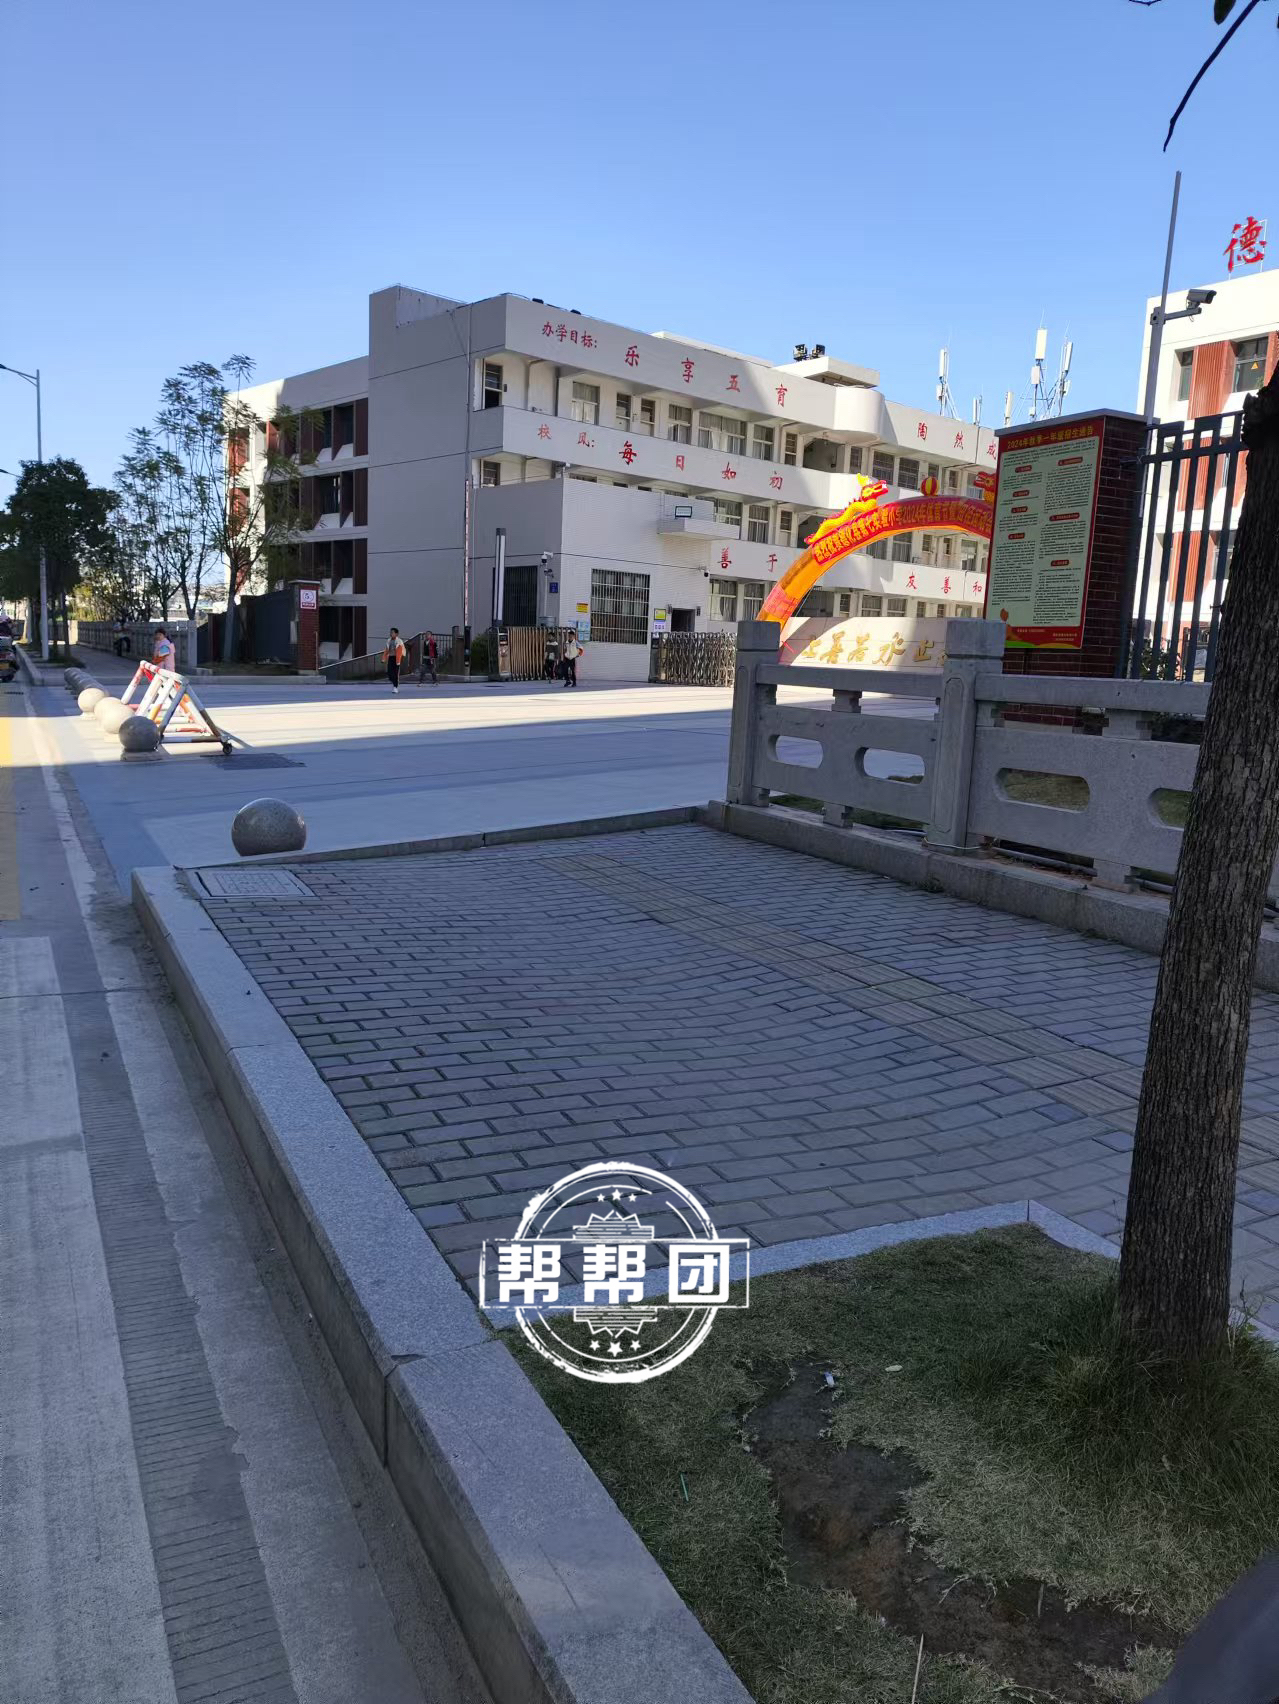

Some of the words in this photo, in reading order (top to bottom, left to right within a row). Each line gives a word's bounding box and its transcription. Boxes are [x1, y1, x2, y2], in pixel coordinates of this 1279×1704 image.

[1223, 216, 1267, 273] 德
[541, 321, 598, 349] 办学目标:
